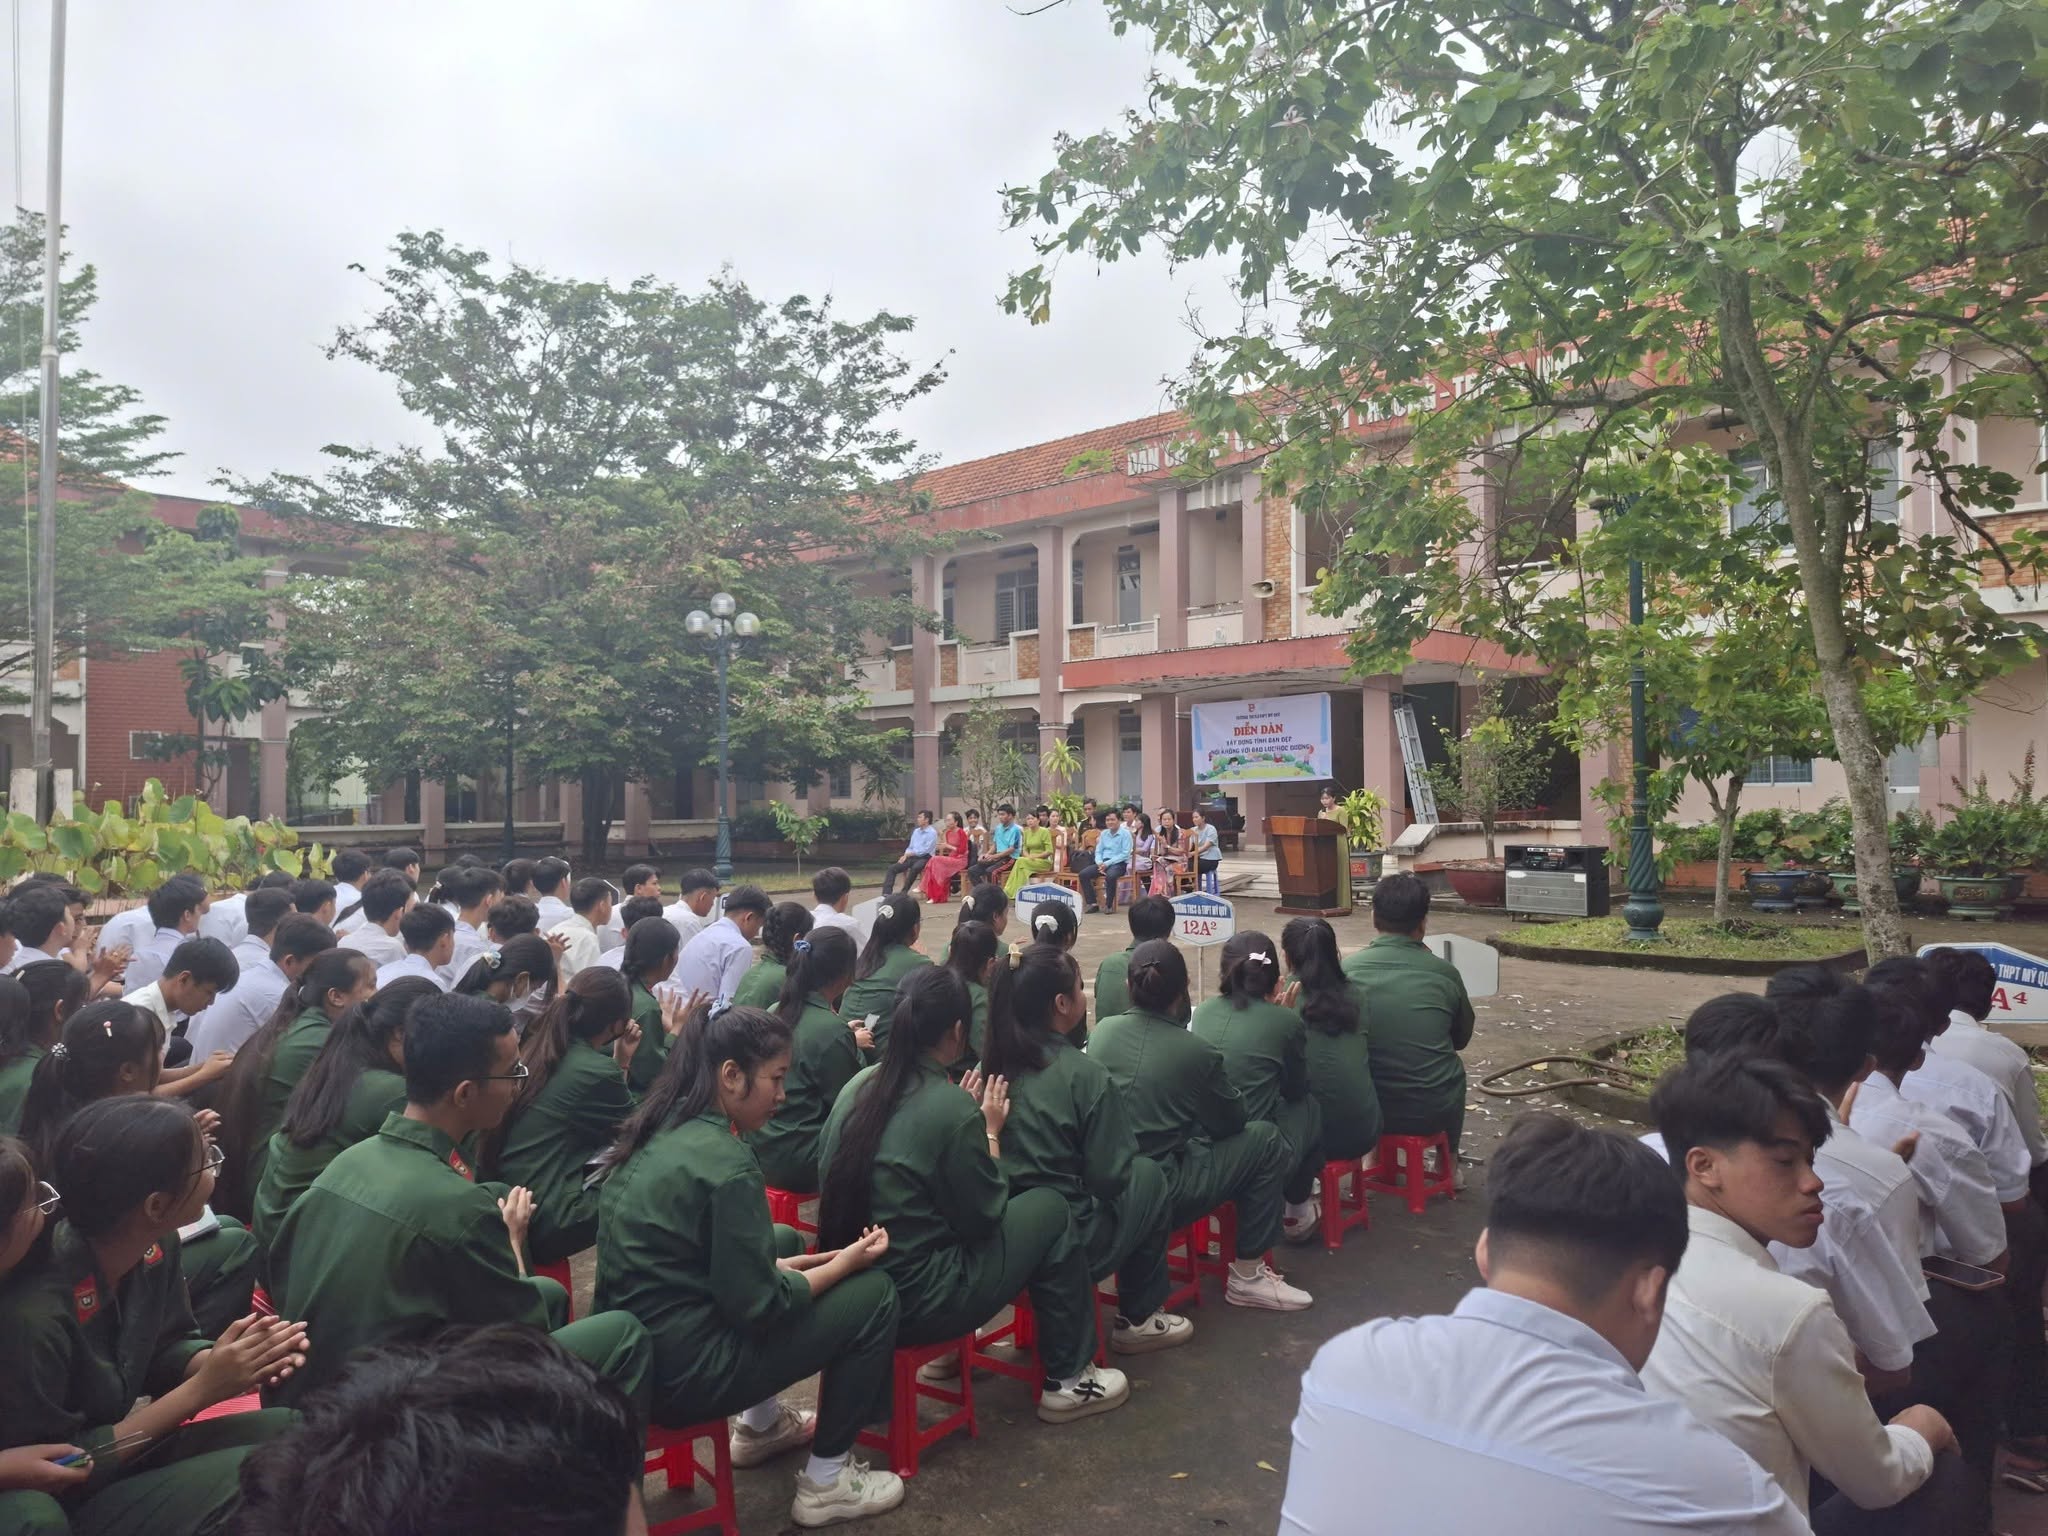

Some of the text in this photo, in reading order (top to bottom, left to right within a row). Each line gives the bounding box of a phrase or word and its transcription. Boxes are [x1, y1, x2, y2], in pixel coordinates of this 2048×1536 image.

[1234, 721, 1258, 736] DIỄN
[1998, 963, 2021, 981] THPT
[2021, 967, 2038, 984] MỸ
[2038, 970, 2048, 987] QU
